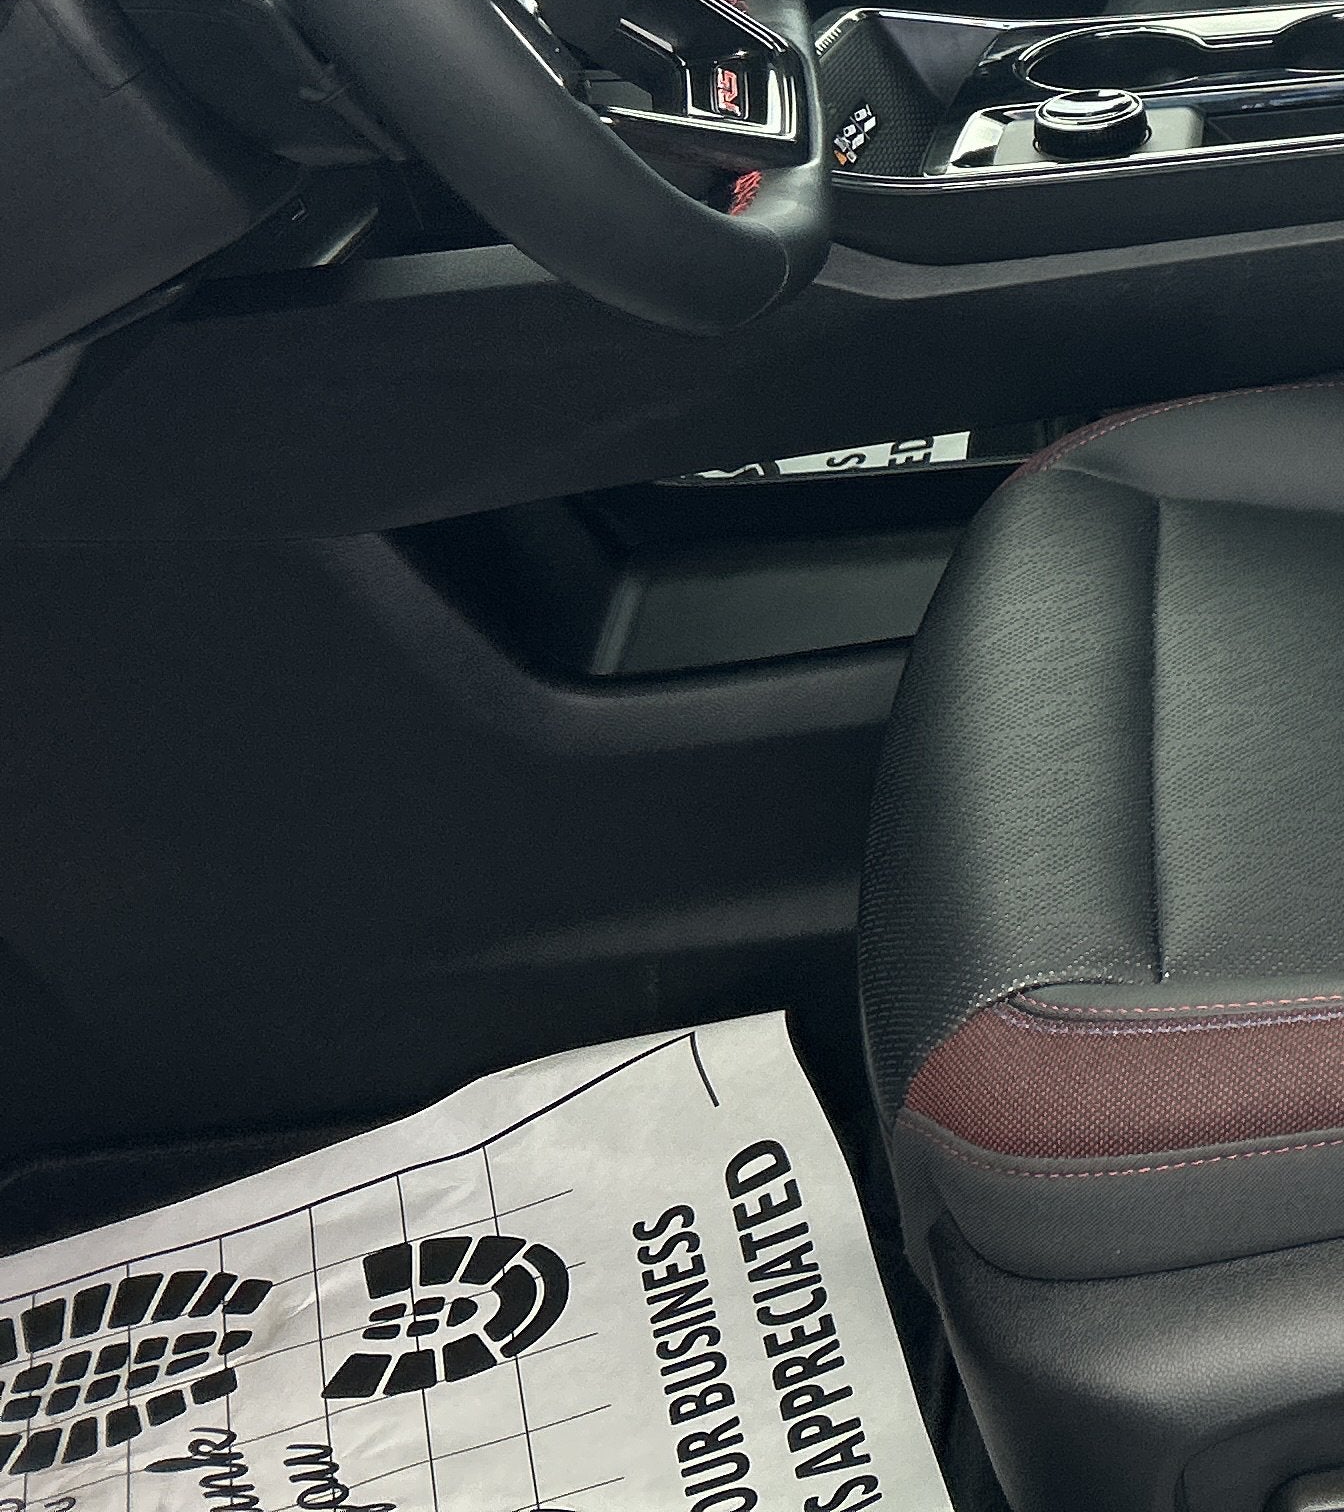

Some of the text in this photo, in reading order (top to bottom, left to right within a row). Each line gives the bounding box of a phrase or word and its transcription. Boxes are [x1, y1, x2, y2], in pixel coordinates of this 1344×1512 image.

[717, 67, 739, 116] RS
[632, 1204, 736, 1426] BUSINESS
[725, 1139, 872, 1479] APPRECIATED
